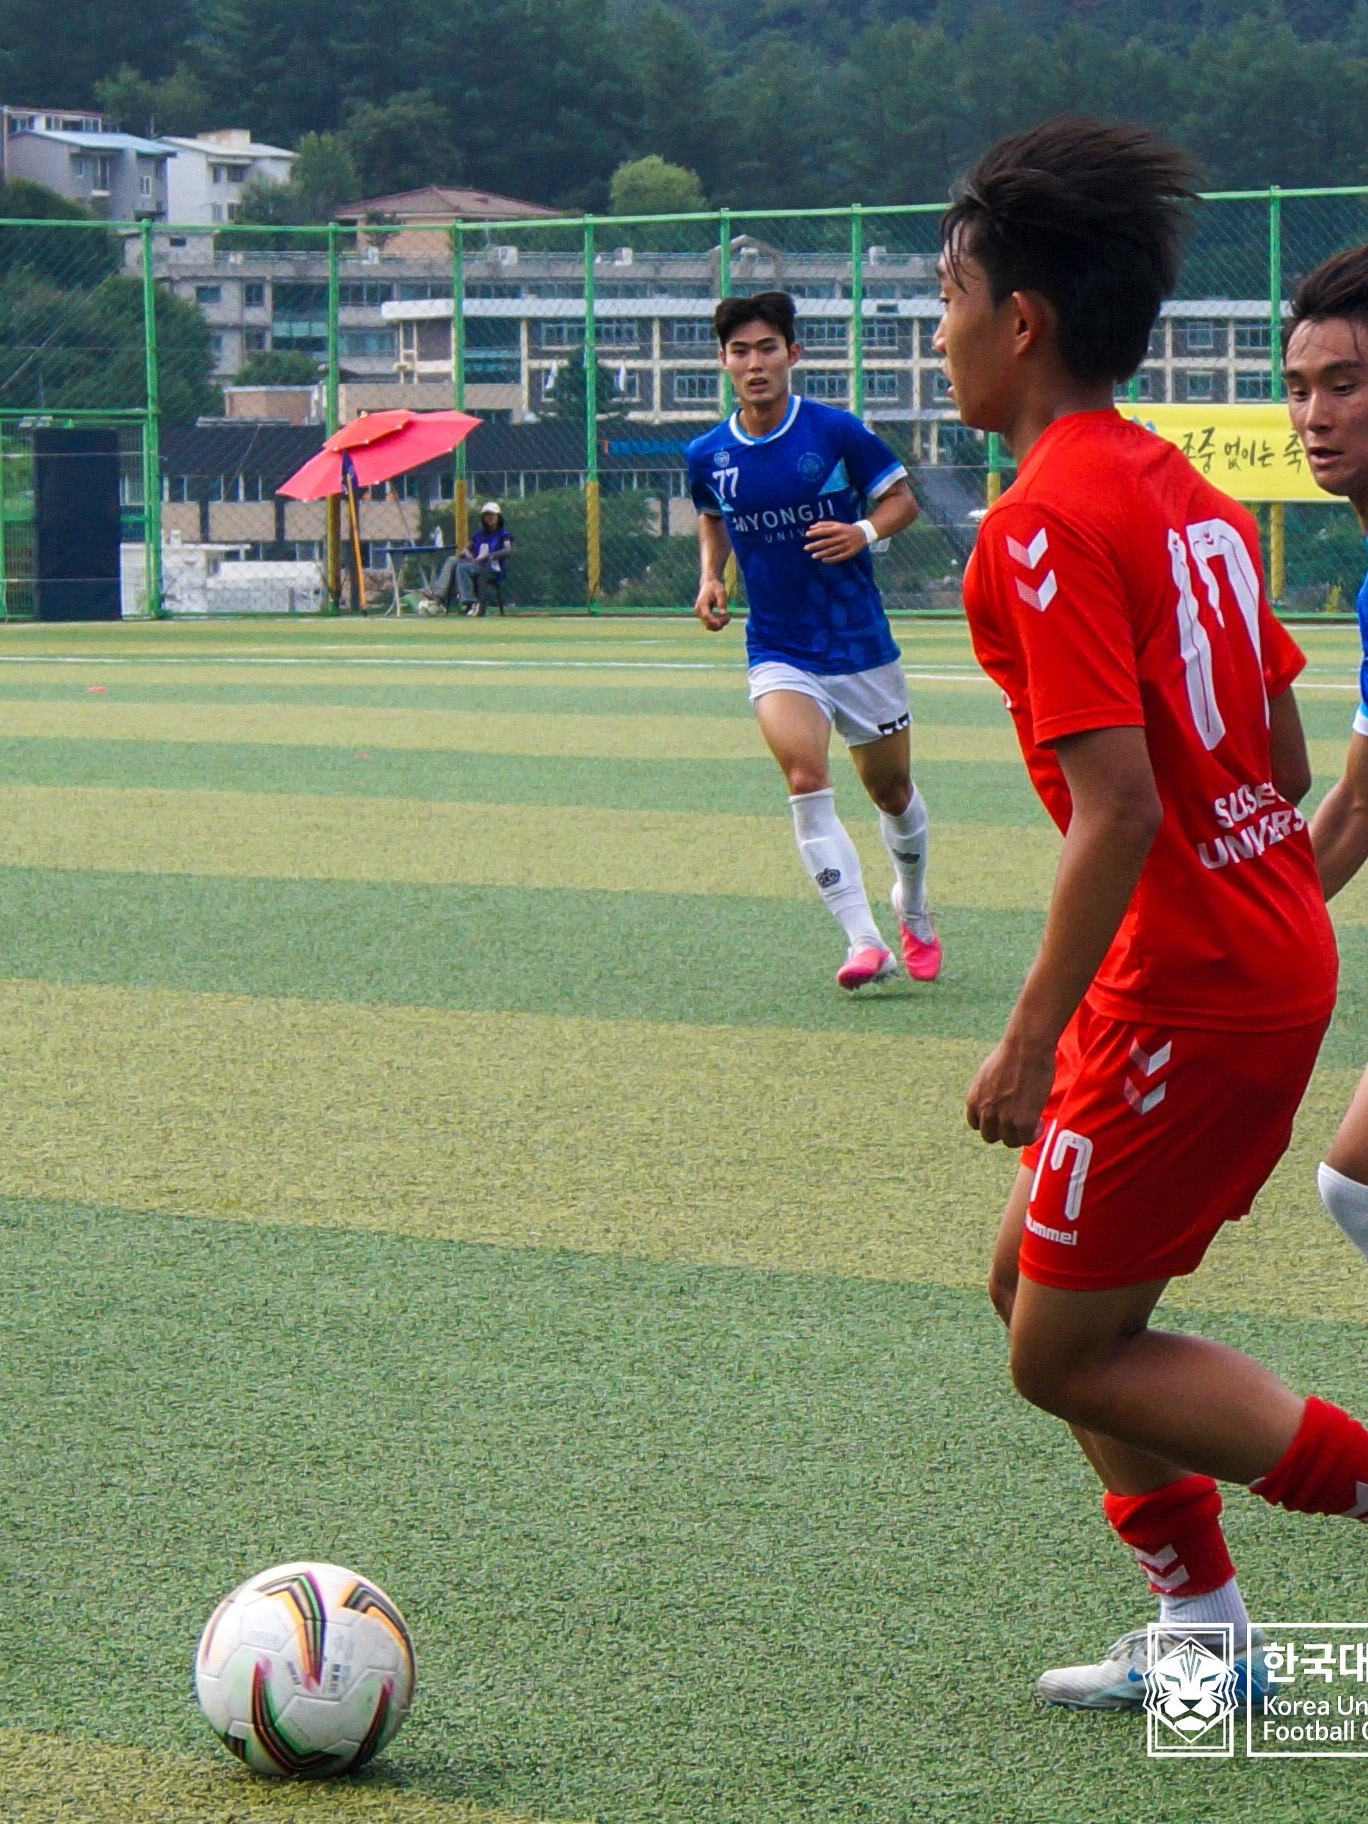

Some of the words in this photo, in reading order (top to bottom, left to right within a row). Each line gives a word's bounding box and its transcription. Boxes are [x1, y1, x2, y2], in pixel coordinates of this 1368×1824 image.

[1224, 435, 1275, 471] 없이는
[712, 466, 739, 500] 77
[733, 499, 835, 533] MYONGJI
[1029, 1117, 1094, 1221] 17
